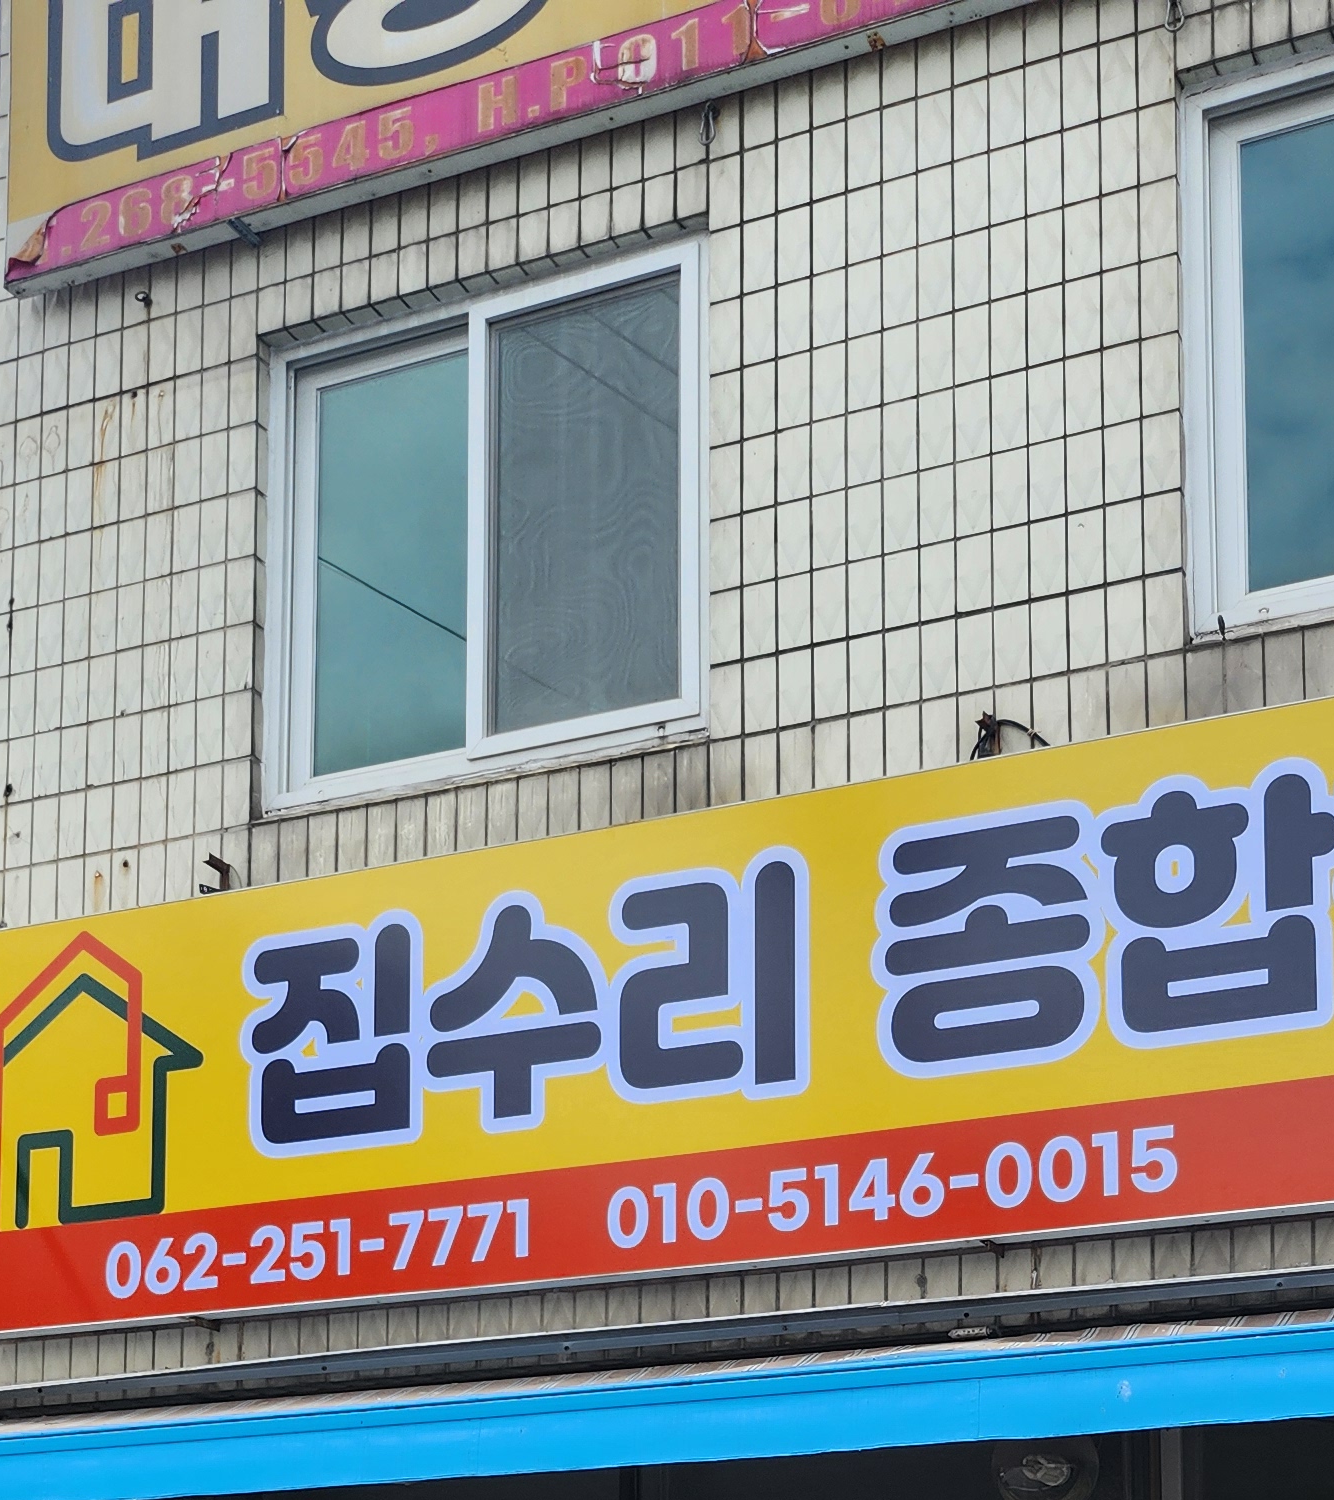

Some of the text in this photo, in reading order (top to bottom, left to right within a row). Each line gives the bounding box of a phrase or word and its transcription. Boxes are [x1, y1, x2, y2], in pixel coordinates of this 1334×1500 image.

[244, 852, 805, 1154] 집수리
[103, 1123, 1180, 1300] 062-251-7771 010-5146-0015
